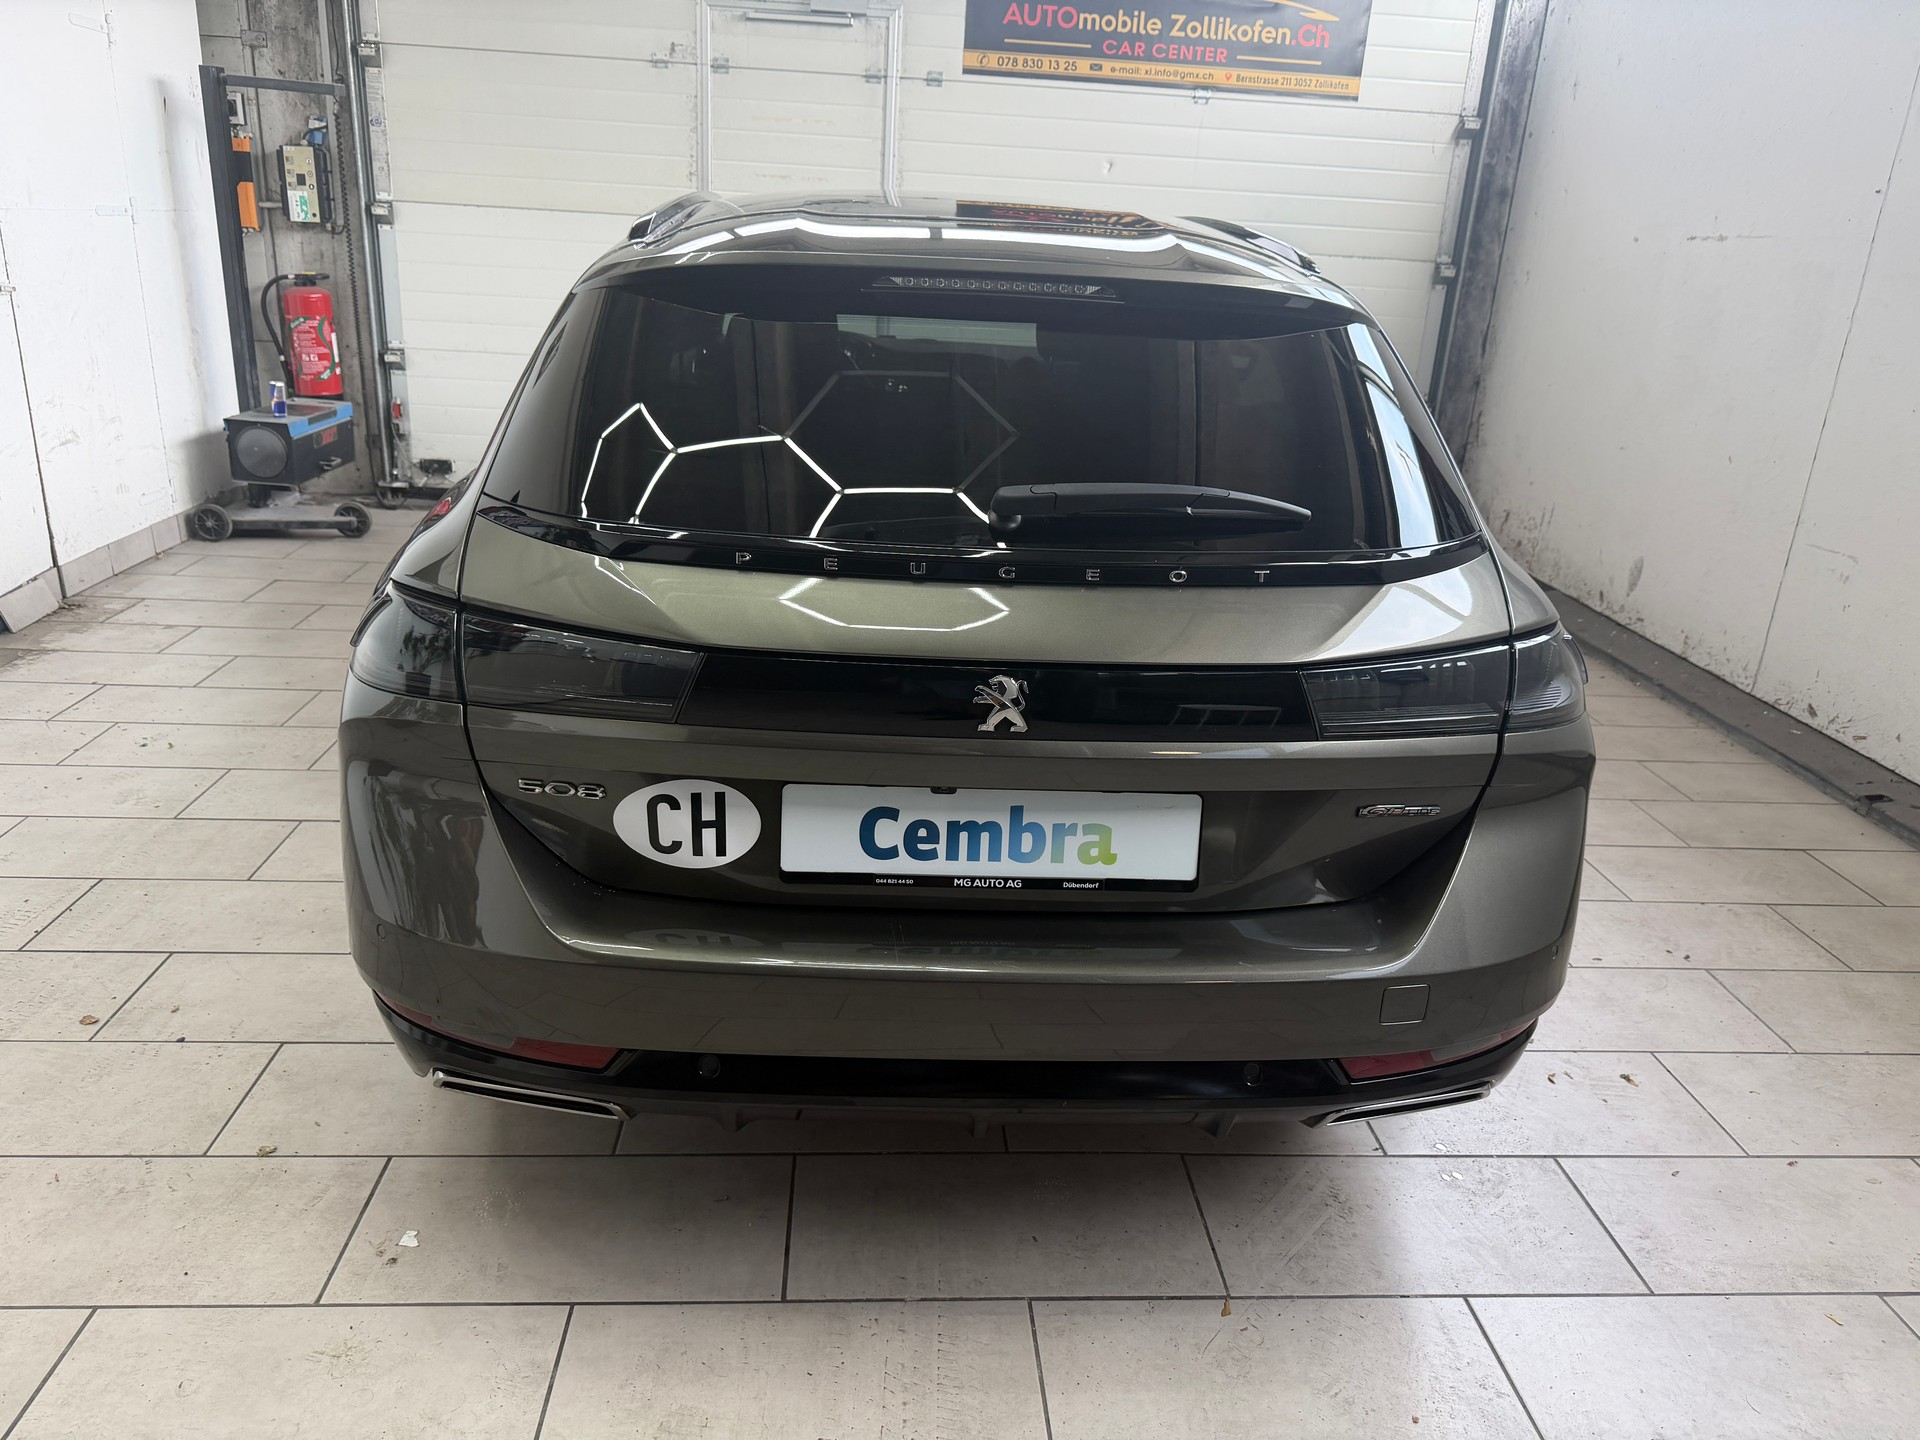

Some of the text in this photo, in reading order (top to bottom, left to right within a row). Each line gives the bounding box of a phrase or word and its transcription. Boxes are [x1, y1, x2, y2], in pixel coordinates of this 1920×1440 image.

[1003, 2, 1330, 48] AUTOmobile Zollikofen.Ch
[1103, 39, 1228, 63] CAR CENTER
[997, 56, 1078, 71] 078 830 13 25
[1110, 65, 1142, 75] e-mail:
[1235, 73, 1279, 86] Bernstrasse
[1280, 76, 1292, 86] 211
[1294, 77, 1312, 87] 3052
[735, 551, 1270, 583] PEUGEOT
[517, 778, 607, 800] 508
[646, 791, 728, 858] CH
[858, 804, 1118, 866] Cembra
[953, 878, 1022, 888] MG AUTO AG
[1062, 881, 1100, 889] Dübendorf
